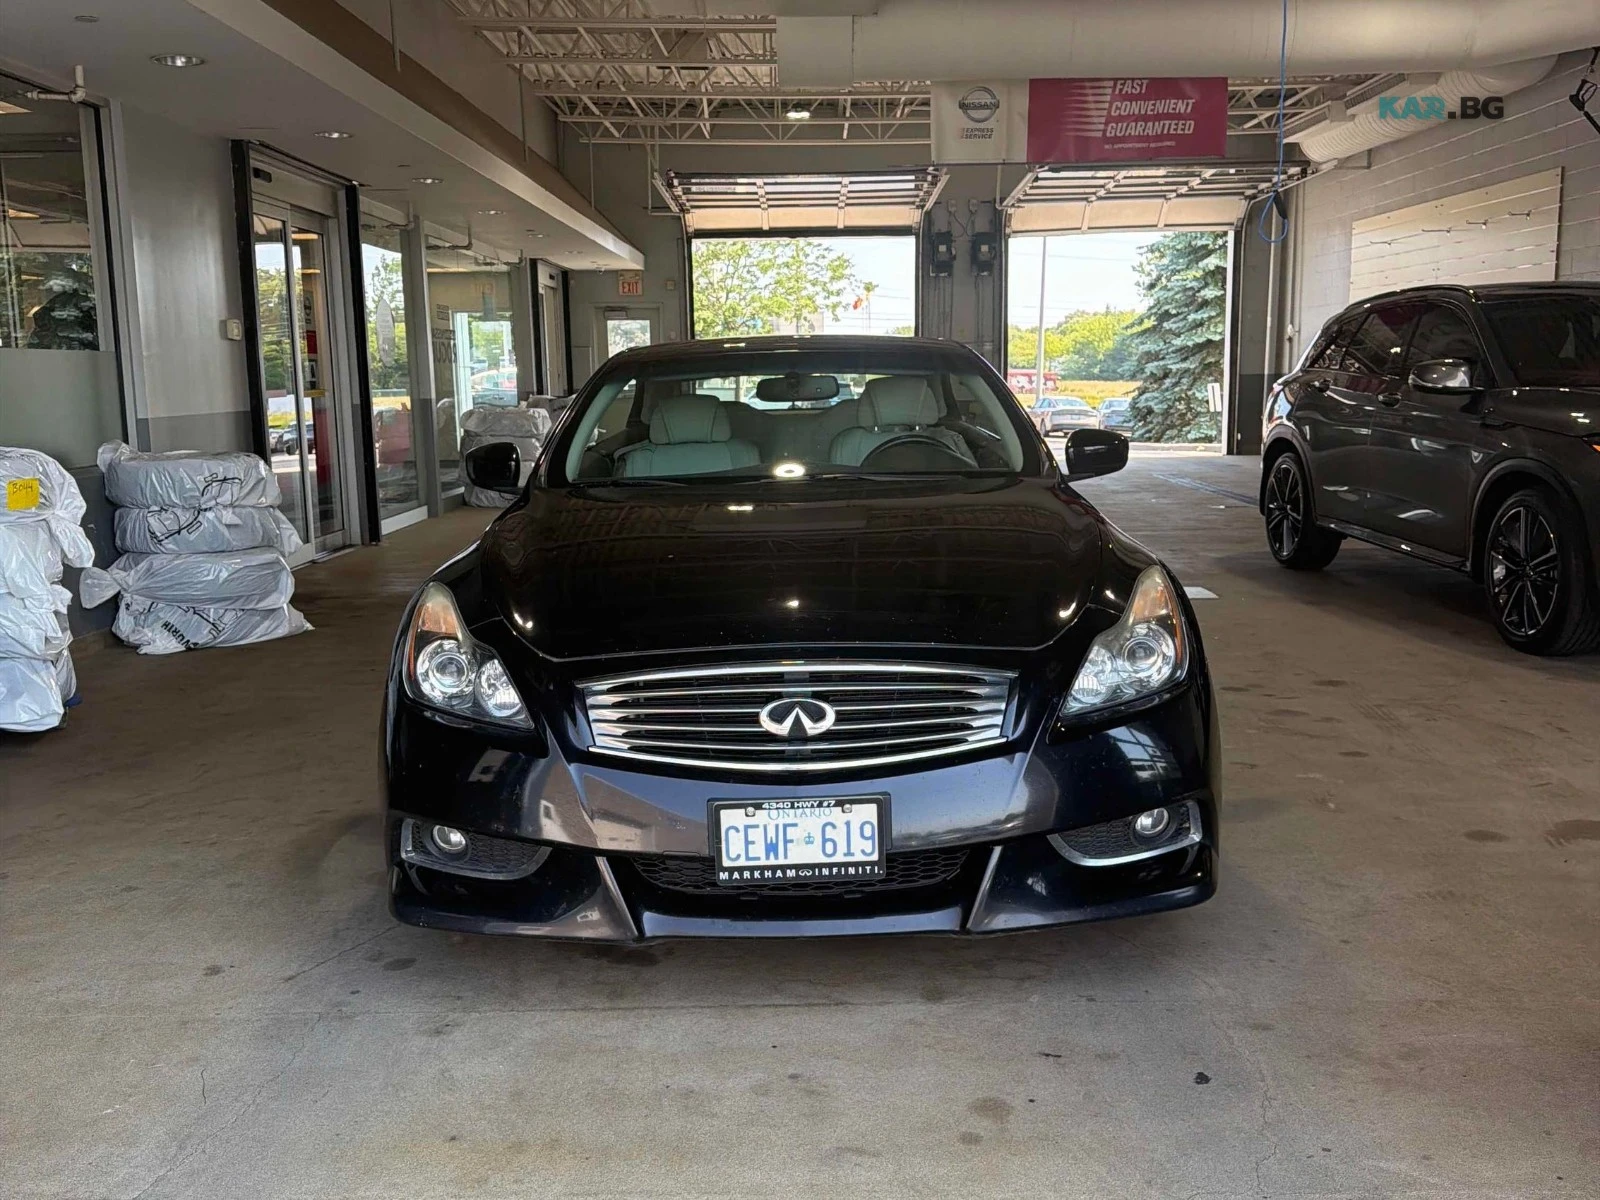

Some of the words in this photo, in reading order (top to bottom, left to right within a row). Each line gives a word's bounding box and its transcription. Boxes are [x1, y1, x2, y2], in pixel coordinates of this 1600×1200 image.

[1115, 80, 1148, 94] FAST
[1111, 99, 1195, 116] CONVENIENT
[1106, 120, 1195, 137] GUARANTEED
[622, 281, 639, 294] EXIT
[761, 802, 791, 810] 4340
[767, 807, 833, 820] ONTARIO
[724, 822, 798, 862] CEWF
[821, 820, 876, 858] 619
[719, 868, 796, 880] MARKHAM
